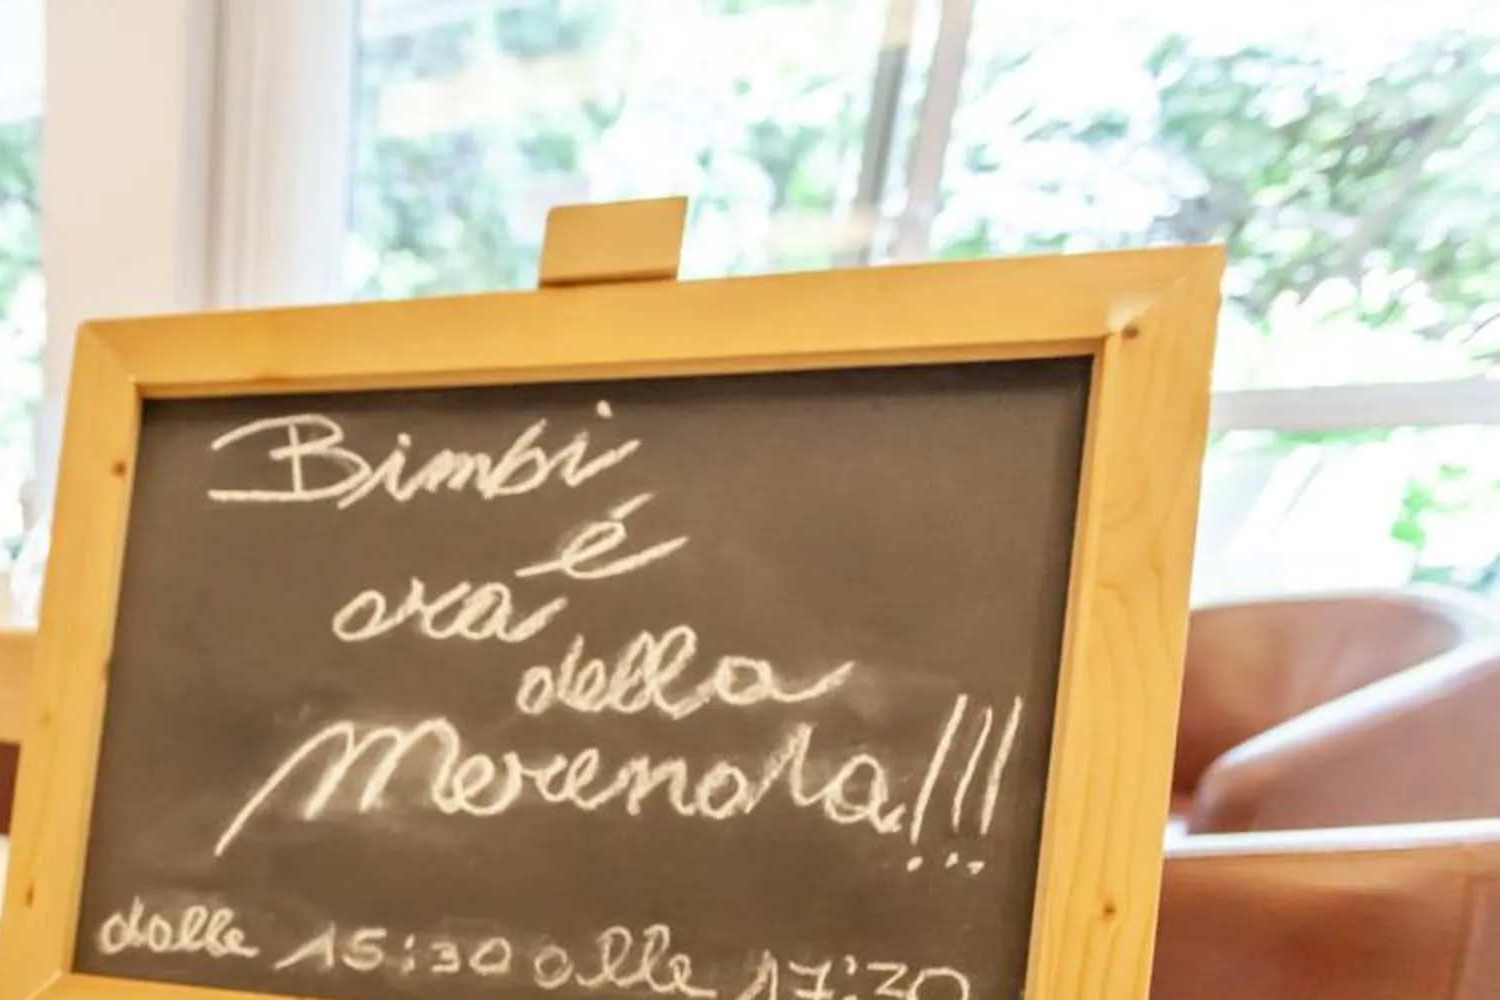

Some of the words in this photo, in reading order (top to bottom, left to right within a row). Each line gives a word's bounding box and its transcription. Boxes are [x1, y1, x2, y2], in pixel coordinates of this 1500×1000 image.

[208, 400, 641, 510] Bimbi
[332, 576, 569, 643] ora
[515, 624, 855, 720] della
[272, 921, 512, 976] 15:30
